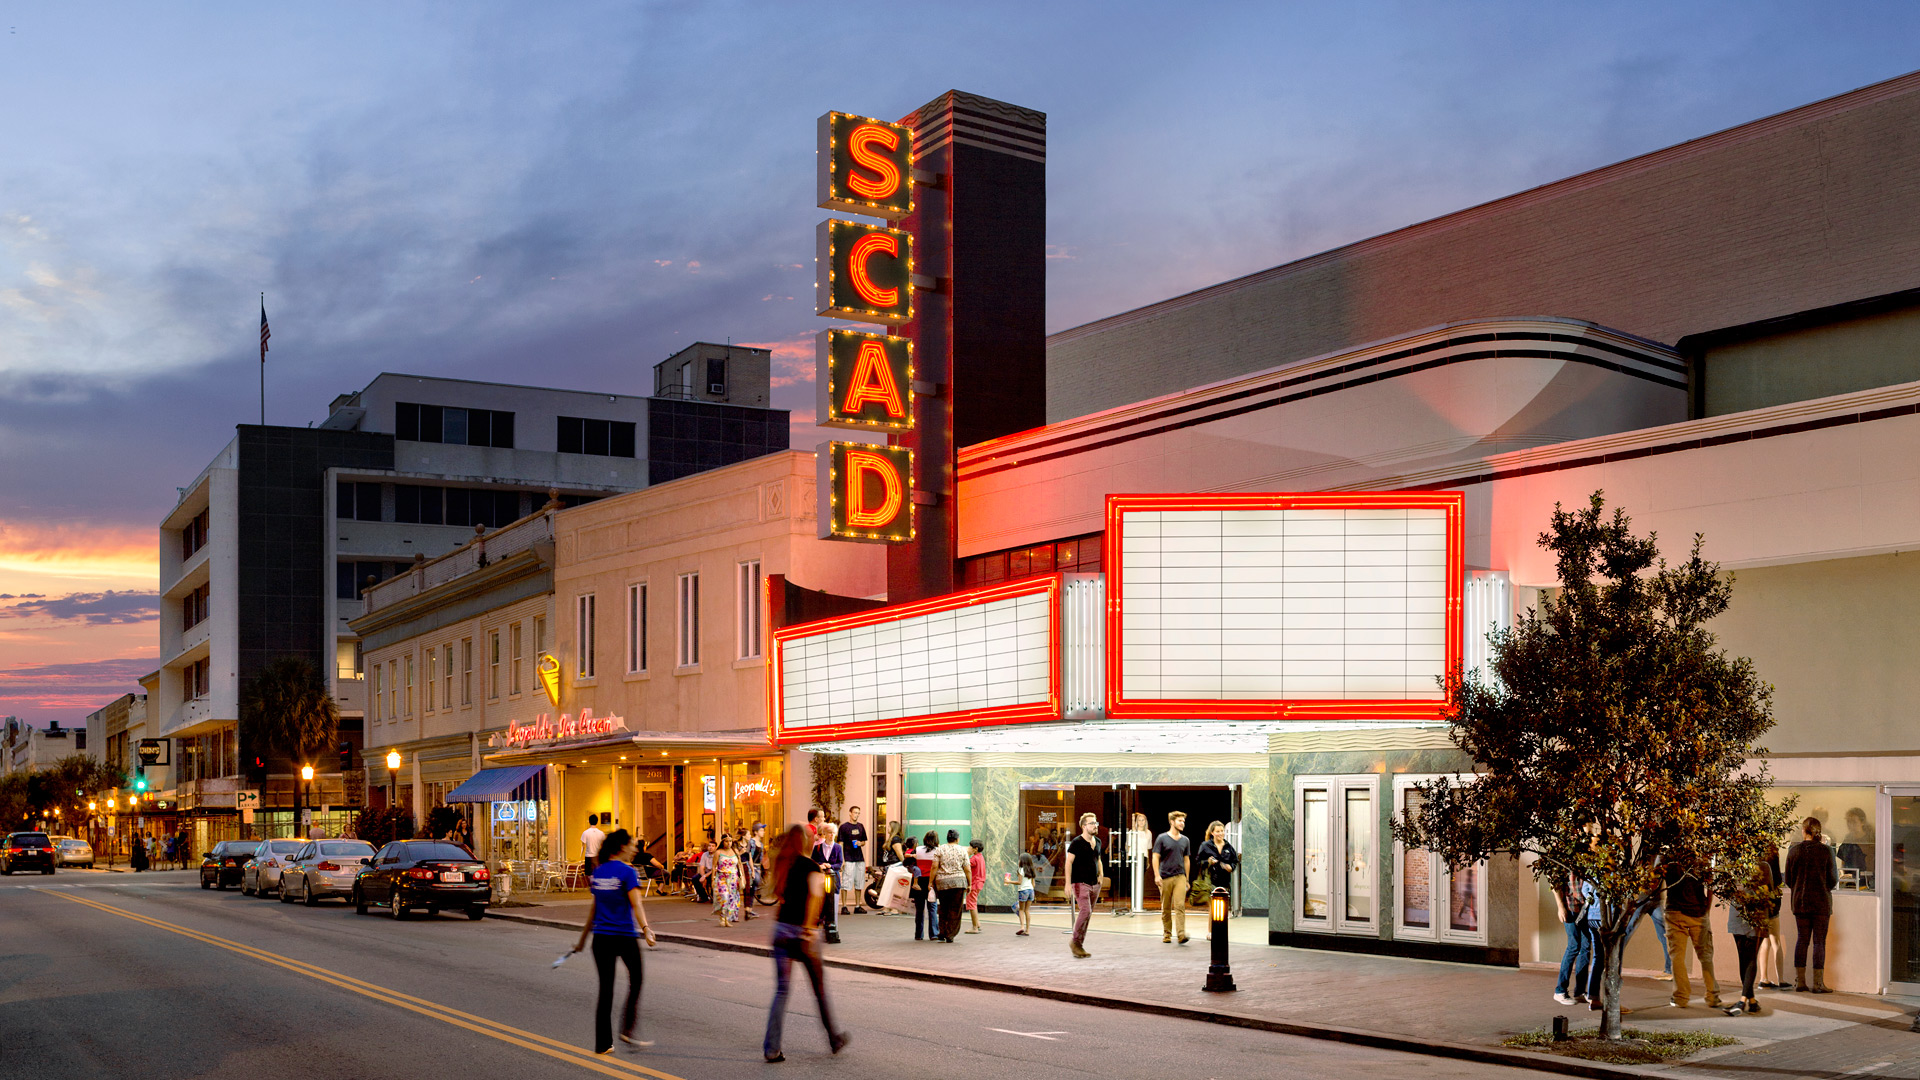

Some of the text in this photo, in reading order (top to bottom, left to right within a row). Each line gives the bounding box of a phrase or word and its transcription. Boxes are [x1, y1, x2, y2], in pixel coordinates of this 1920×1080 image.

[506, 707, 613, 749] Leopold's Ice Cream
[733, 777, 776, 800] Leopold's
